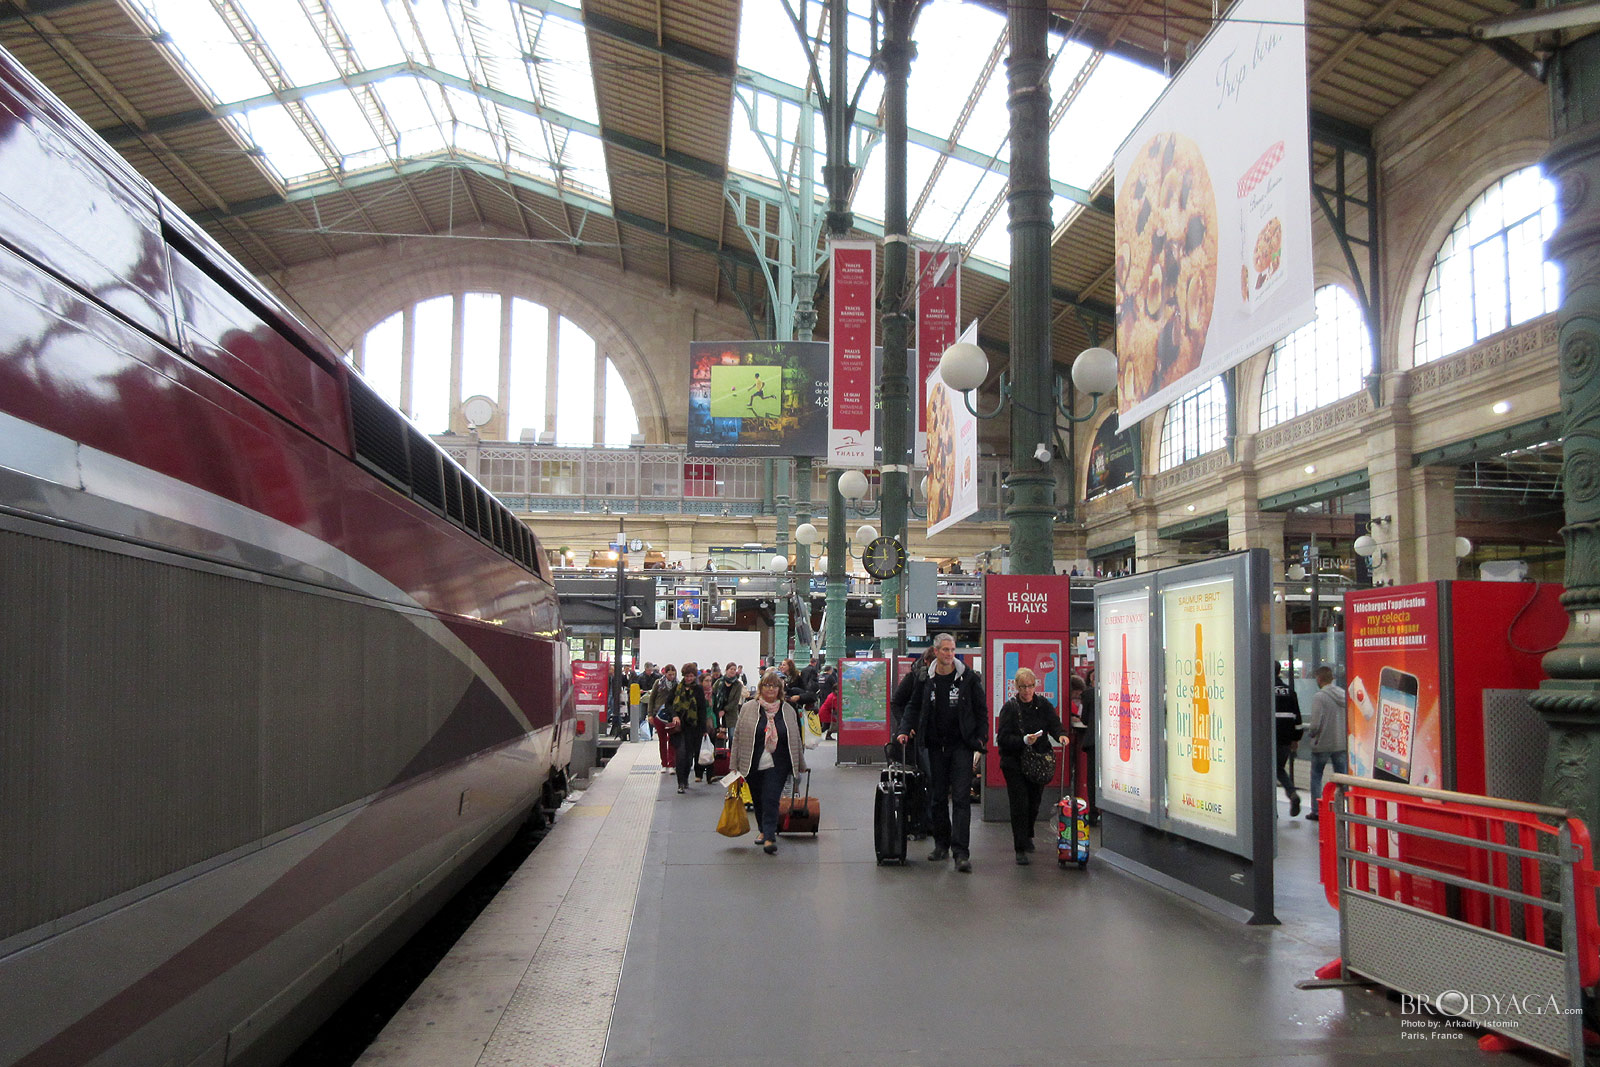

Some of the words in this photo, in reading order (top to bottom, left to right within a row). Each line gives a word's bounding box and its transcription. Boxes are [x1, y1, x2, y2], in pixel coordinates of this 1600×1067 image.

[1007, 592, 1018, 602] LE
[1020, 592, 1048, 603] QUAI
[1179, 594, 1203, 606] SAUMUR
[1204, 592, 1221, 602] BRUT
[1353, 602, 1387, 613] Téléchargez
[1388, 597, 1426, 610] l'application
[1007, 602, 1048, 613] THALYS
[1367, 615, 1380, 626] my
[1382, 611, 1411, 624] selecta
[1387, 625, 1395, 634] de
[1353, 638, 1363, 647] DES
[1391, 636, 1398, 645] DE
[1175, 651, 1225, 676] habillé
[1176, 679, 1188, 698] de
[1190, 685, 1201, 699] sa
[1202, 680, 1225, 700] robe
[1177, 742, 1185, 757] IL
[1196, 799, 1205, 811] DE
[1205, 801, 1222, 815] LOIRE
